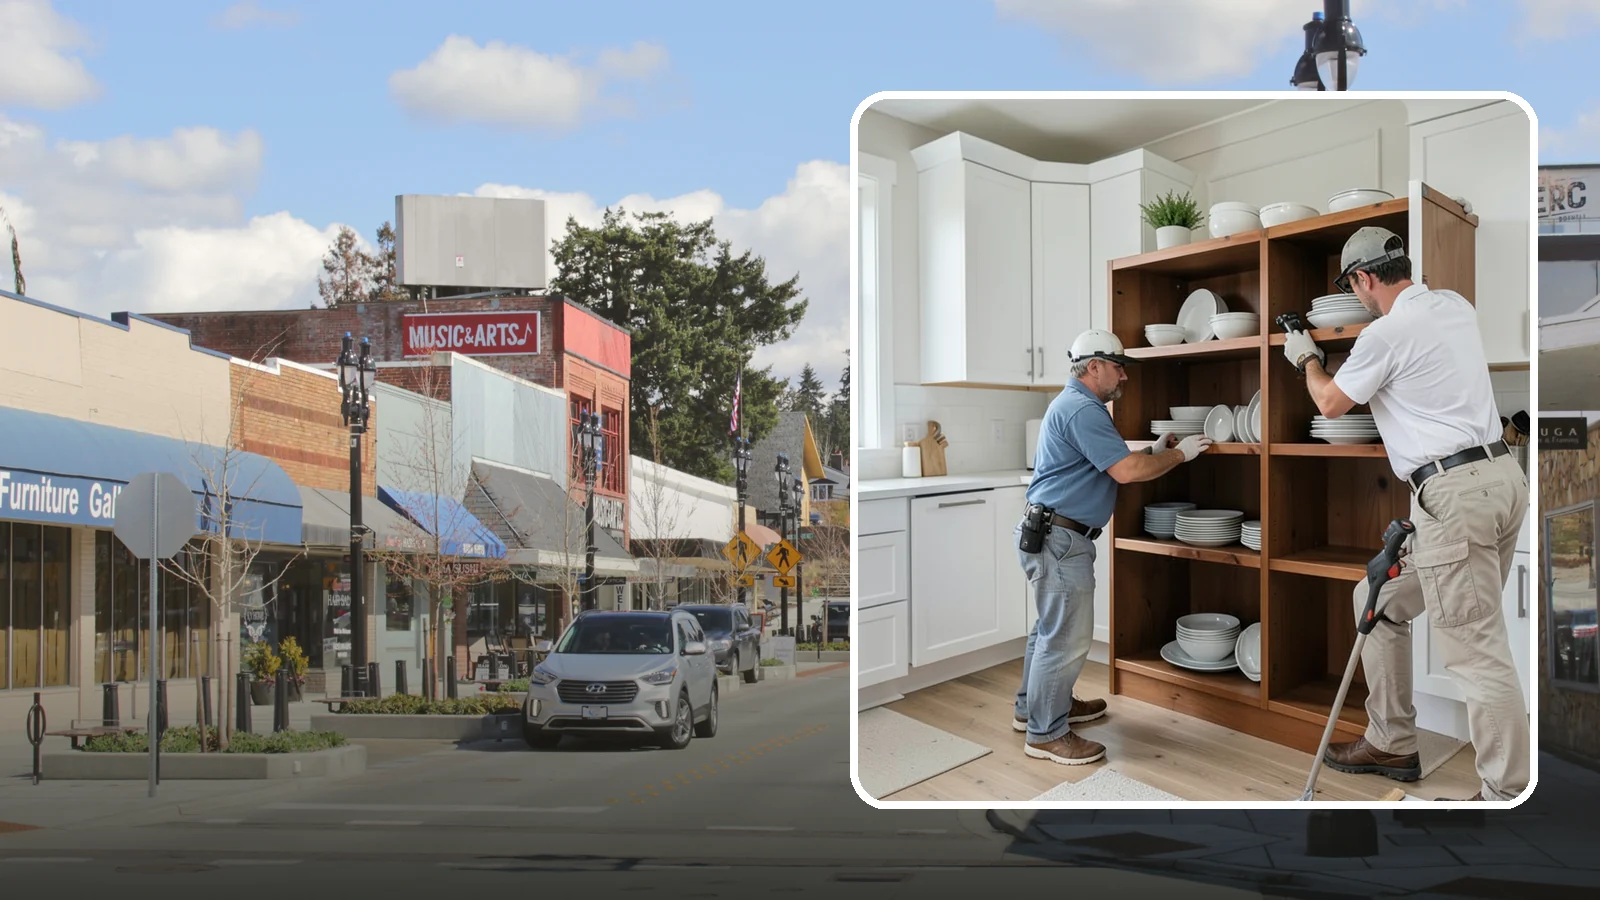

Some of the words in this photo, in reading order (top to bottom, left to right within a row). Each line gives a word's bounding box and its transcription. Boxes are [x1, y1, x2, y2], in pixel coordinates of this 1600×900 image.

[408, 323, 520, 348] MUSIC&ARTS
[0, 471, 79, 515] Furniture
[89, 482, 122, 519] Gal
